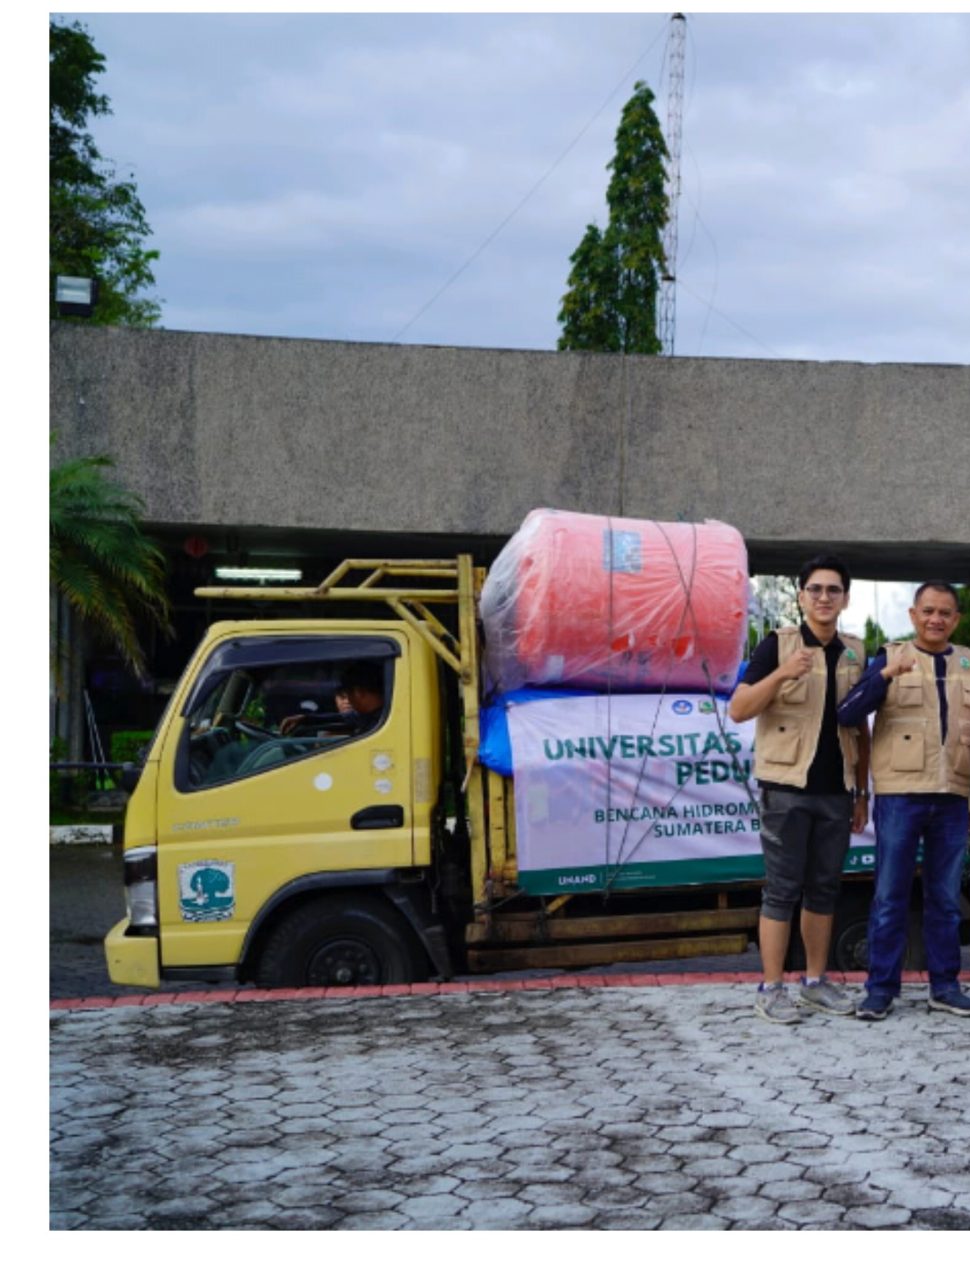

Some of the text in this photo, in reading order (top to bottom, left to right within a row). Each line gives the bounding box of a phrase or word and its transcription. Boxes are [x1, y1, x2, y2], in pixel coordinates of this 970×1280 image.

[543, 731, 742, 760] UNIVERSITAS
[676, 758, 751, 785] PEDU
[594, 801, 758, 823] BENCANA HIDROM
[654, 819, 746, 837] SUMATERA
